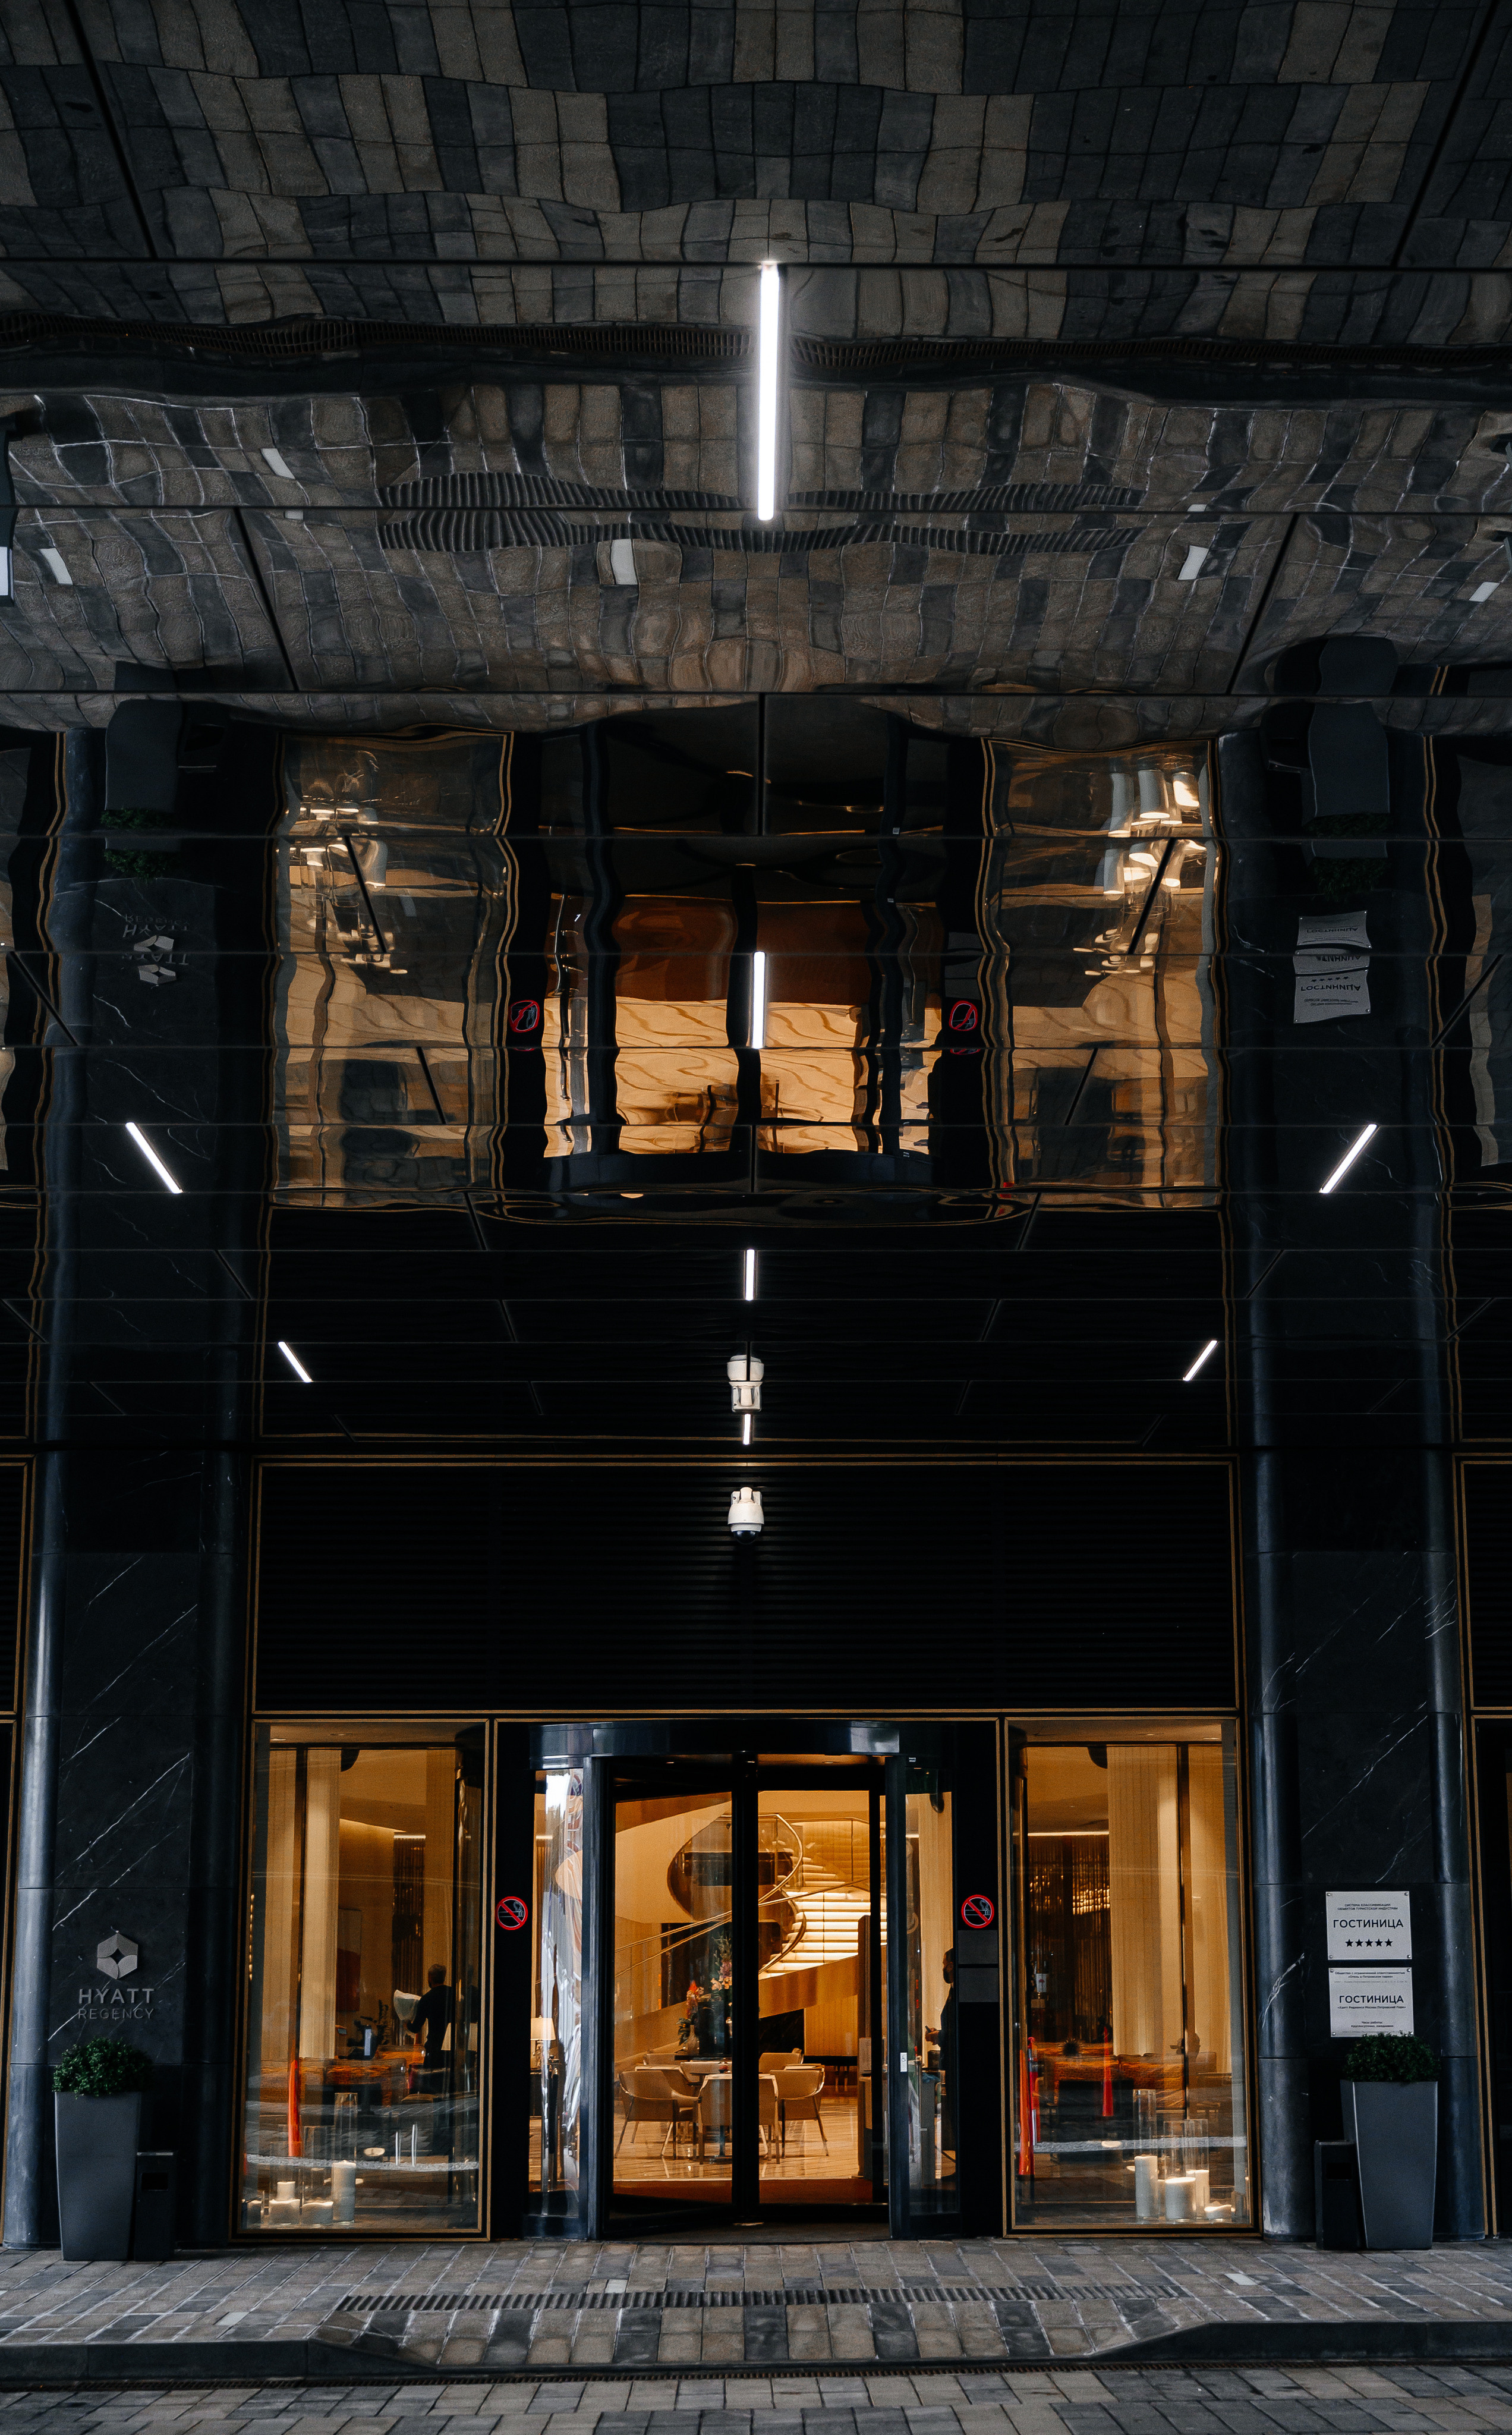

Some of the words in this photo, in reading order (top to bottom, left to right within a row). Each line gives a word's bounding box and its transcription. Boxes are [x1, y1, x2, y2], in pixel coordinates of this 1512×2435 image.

[1333, 1920, 1404, 1929] ГОСТИНИЦА
[78, 1988, 155, 2004] HYATT
[1339, 1995, 1404, 2004] ГОСТИНИЦА
[78, 2008, 155, 2019] REGENCY
